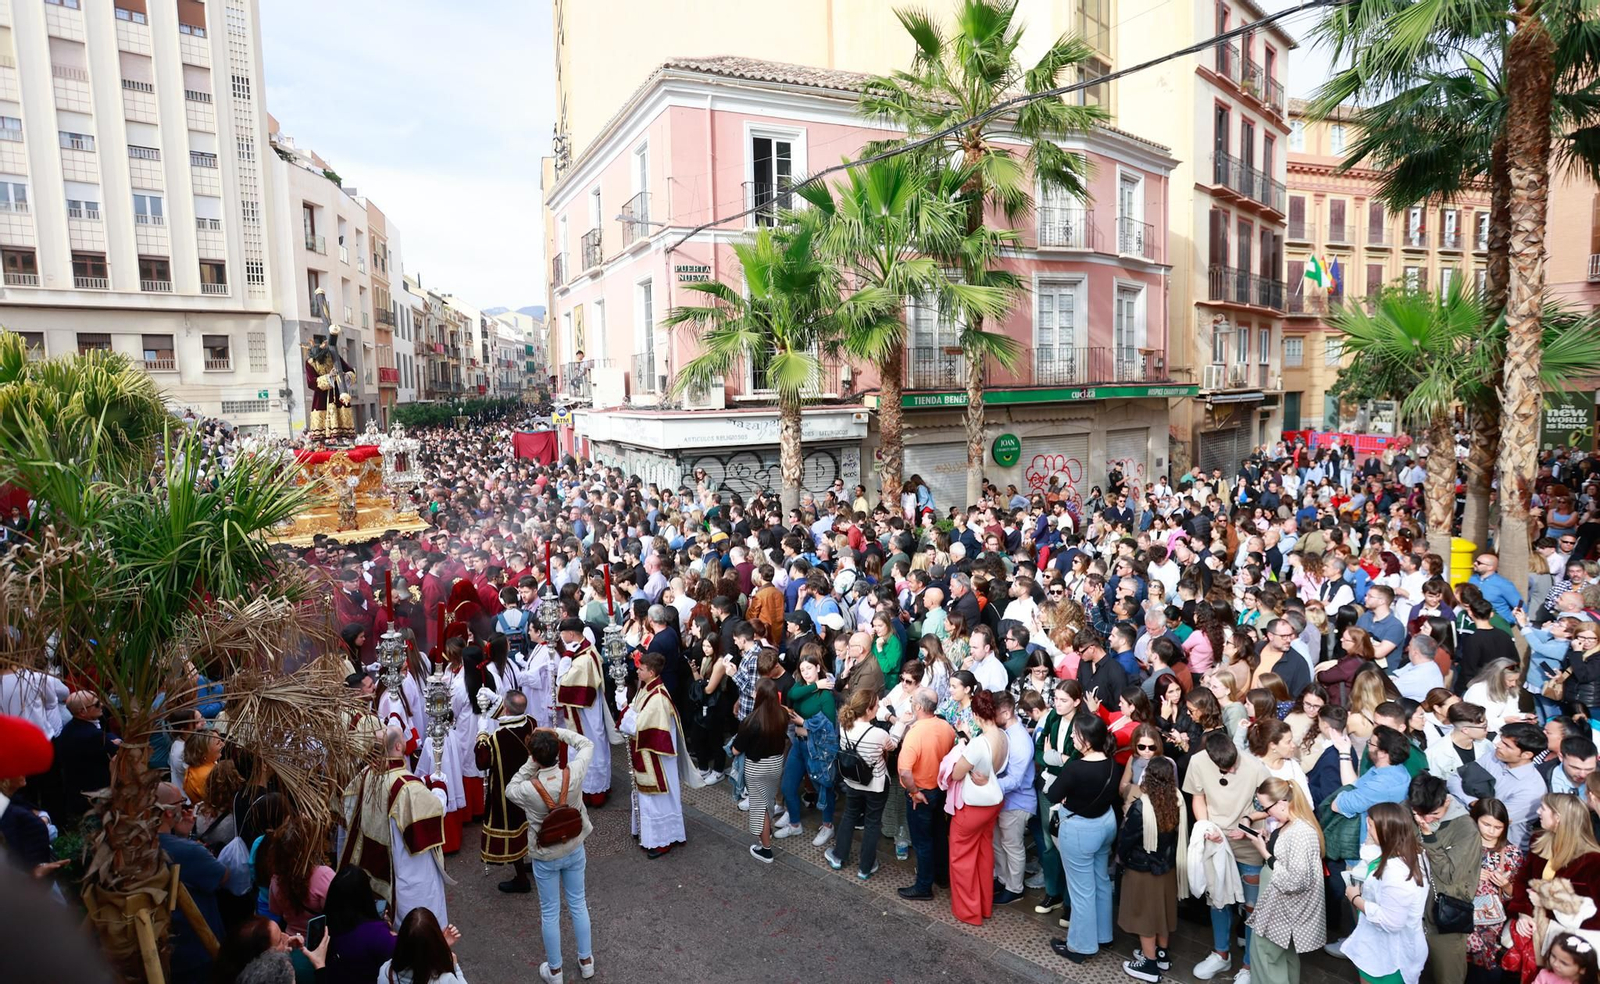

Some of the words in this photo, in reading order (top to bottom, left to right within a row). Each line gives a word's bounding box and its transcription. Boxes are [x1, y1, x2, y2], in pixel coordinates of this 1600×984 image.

[914, 396, 942, 405] TIENDA
[1547, 408, 1588, 417] new
[1000, 439, 1015, 447] JOAN
